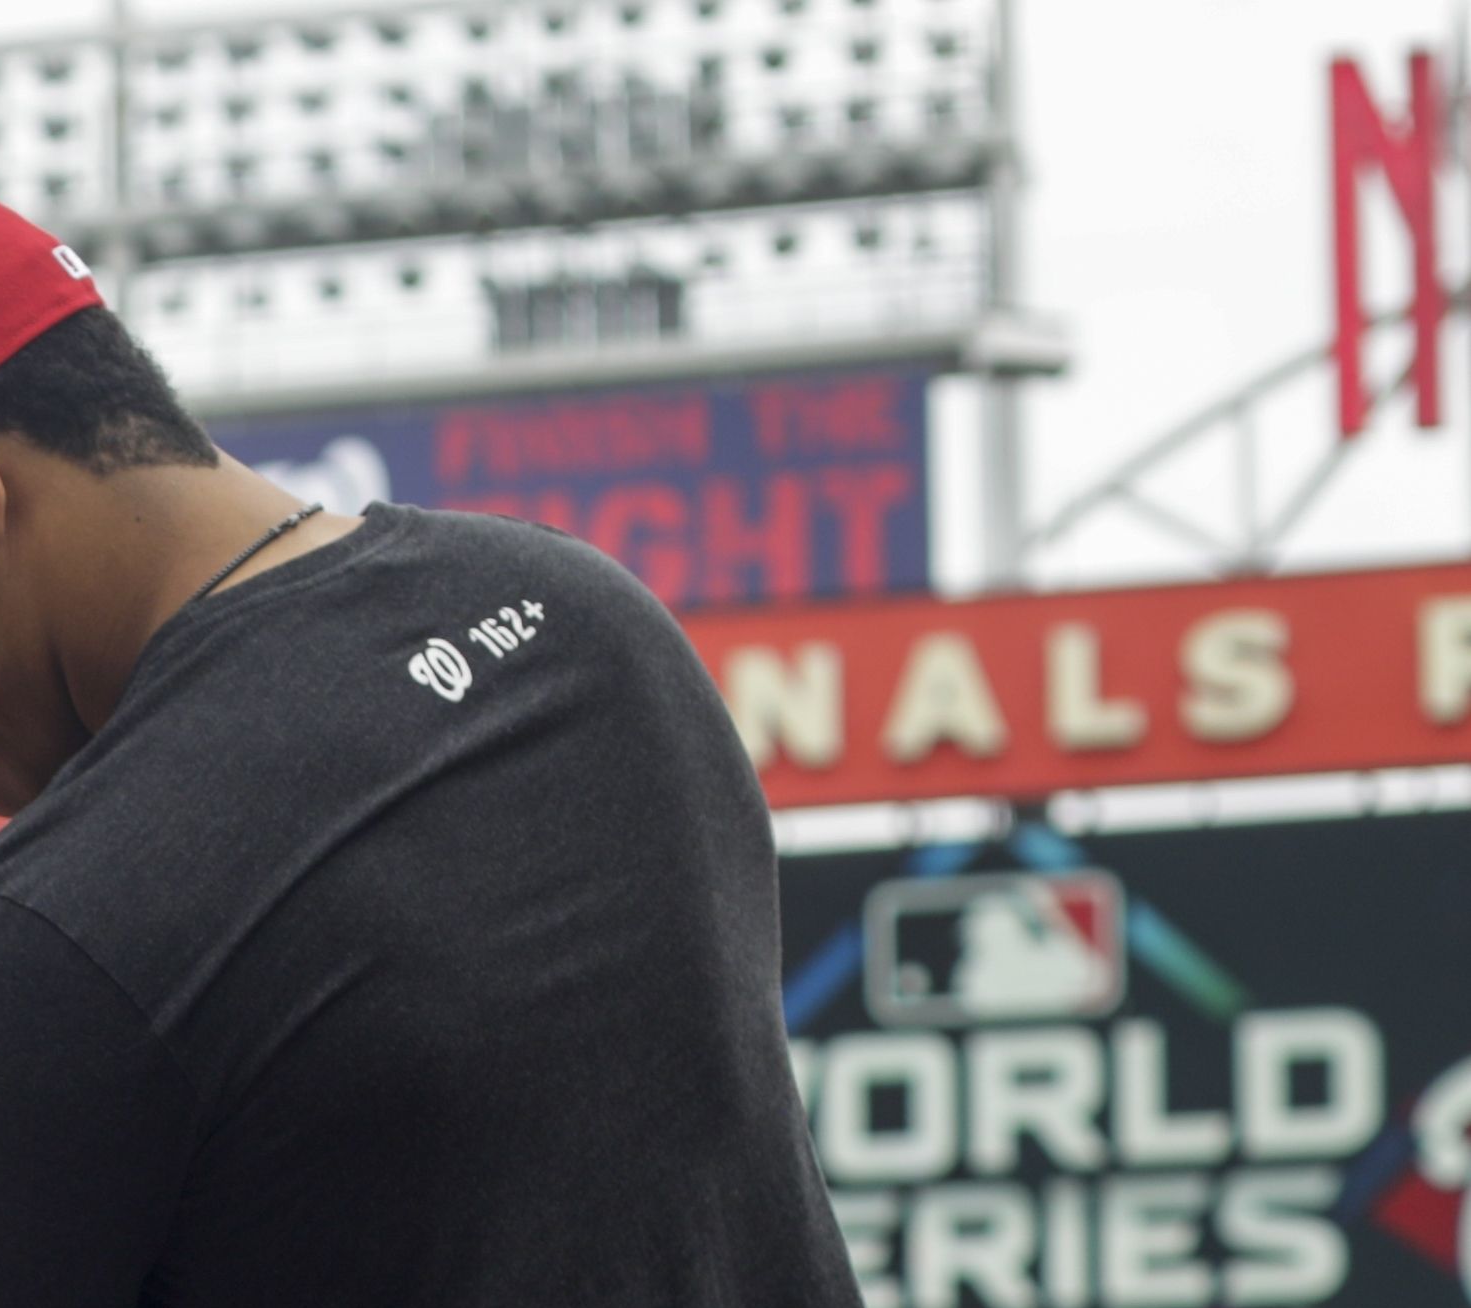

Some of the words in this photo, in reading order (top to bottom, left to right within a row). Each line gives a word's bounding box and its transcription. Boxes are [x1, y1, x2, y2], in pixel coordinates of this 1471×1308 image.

[752, 376, 905, 452] THE
[457, 465, 912, 606] GHT
[468, 599, 545, 660] 162+
[789, 1007, 1384, 1182] ORLD
